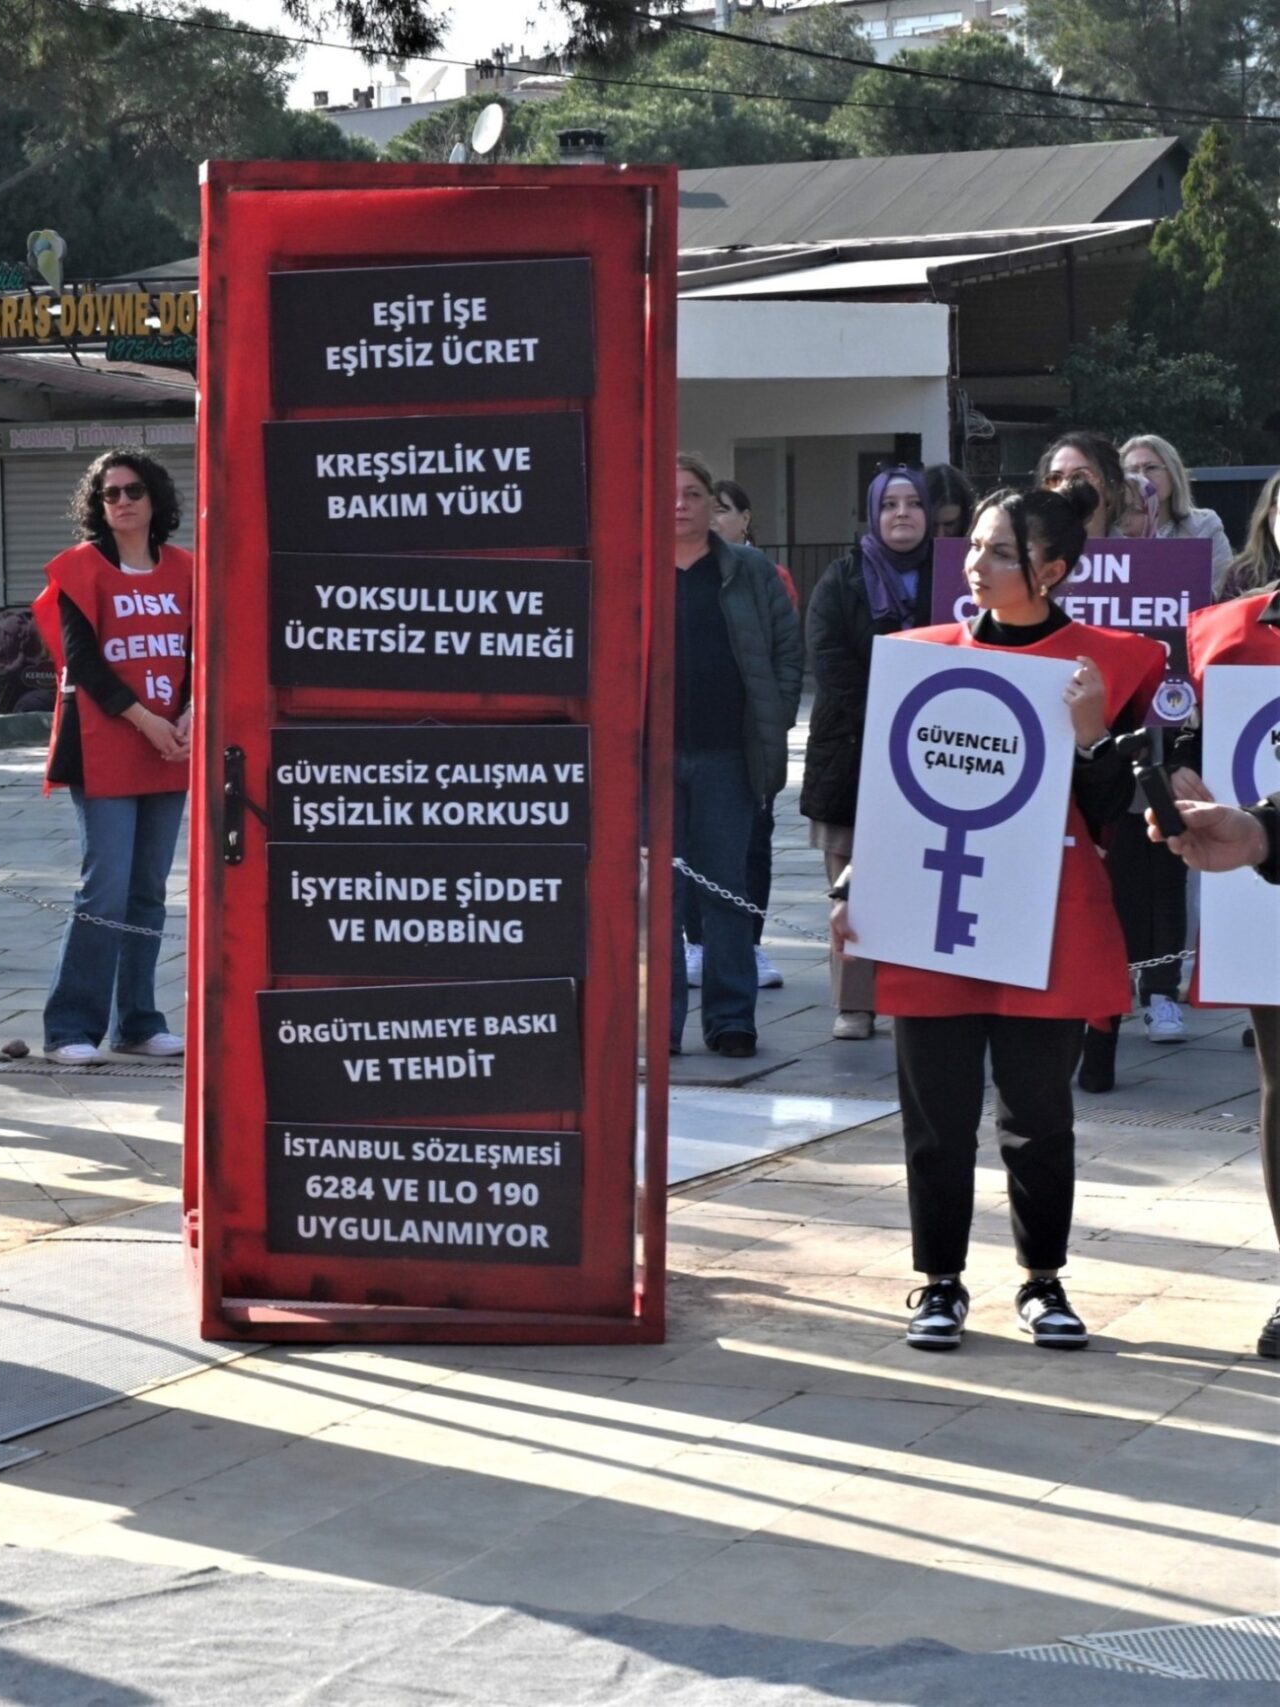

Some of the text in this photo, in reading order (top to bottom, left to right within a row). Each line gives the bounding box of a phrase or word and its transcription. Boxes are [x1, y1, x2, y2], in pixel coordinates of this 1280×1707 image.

[60, 283, 150, 337] DÖVME
[159, 292, 197, 335] DO
[373, 293, 487, 332] EŞİT İŞE
[326, 336, 539, 377] EŞİTSİZ ÜCRET
[316, 443, 531, 483] KREŞSİZLİK VE
[327, 484, 522, 519] BAKIM YÜKÜ
[1067, 553, 1131, 583] DIN
[113, 589, 181, 618] DİSK
[315, 585, 544, 615] YOKSULLUK VE
[285, 621, 574, 659] ÜCRETSİZ EV EMEĞİ
[145, 669, 173, 706] İŞ
[917, 725, 1018, 754] GÜVENCELİ
[277, 760, 584, 789] GÜVENCESİZ ÇALIŞMA VE
[924, 750, 1005, 776] ÇALIŞMA
[293, 796, 569, 832] İŞSİZLİK KORKUSU
[291, 870, 563, 909] İŞYERİNDE ŞİDDET
[328, 913, 524, 944] VE MOBBİNG
[278, 1013, 557, 1044] ÖRGÜTLENMEYE BASKI
[343, 1048, 495, 1082] VE TEHDİT
[284, 1134, 561, 1168] İSTANBUL SÖZLEŞMESİ
[306, 1175, 539, 1207] 6284 VE ILO 190
[297, 1215, 549, 1248] UYGULANMIYOR
